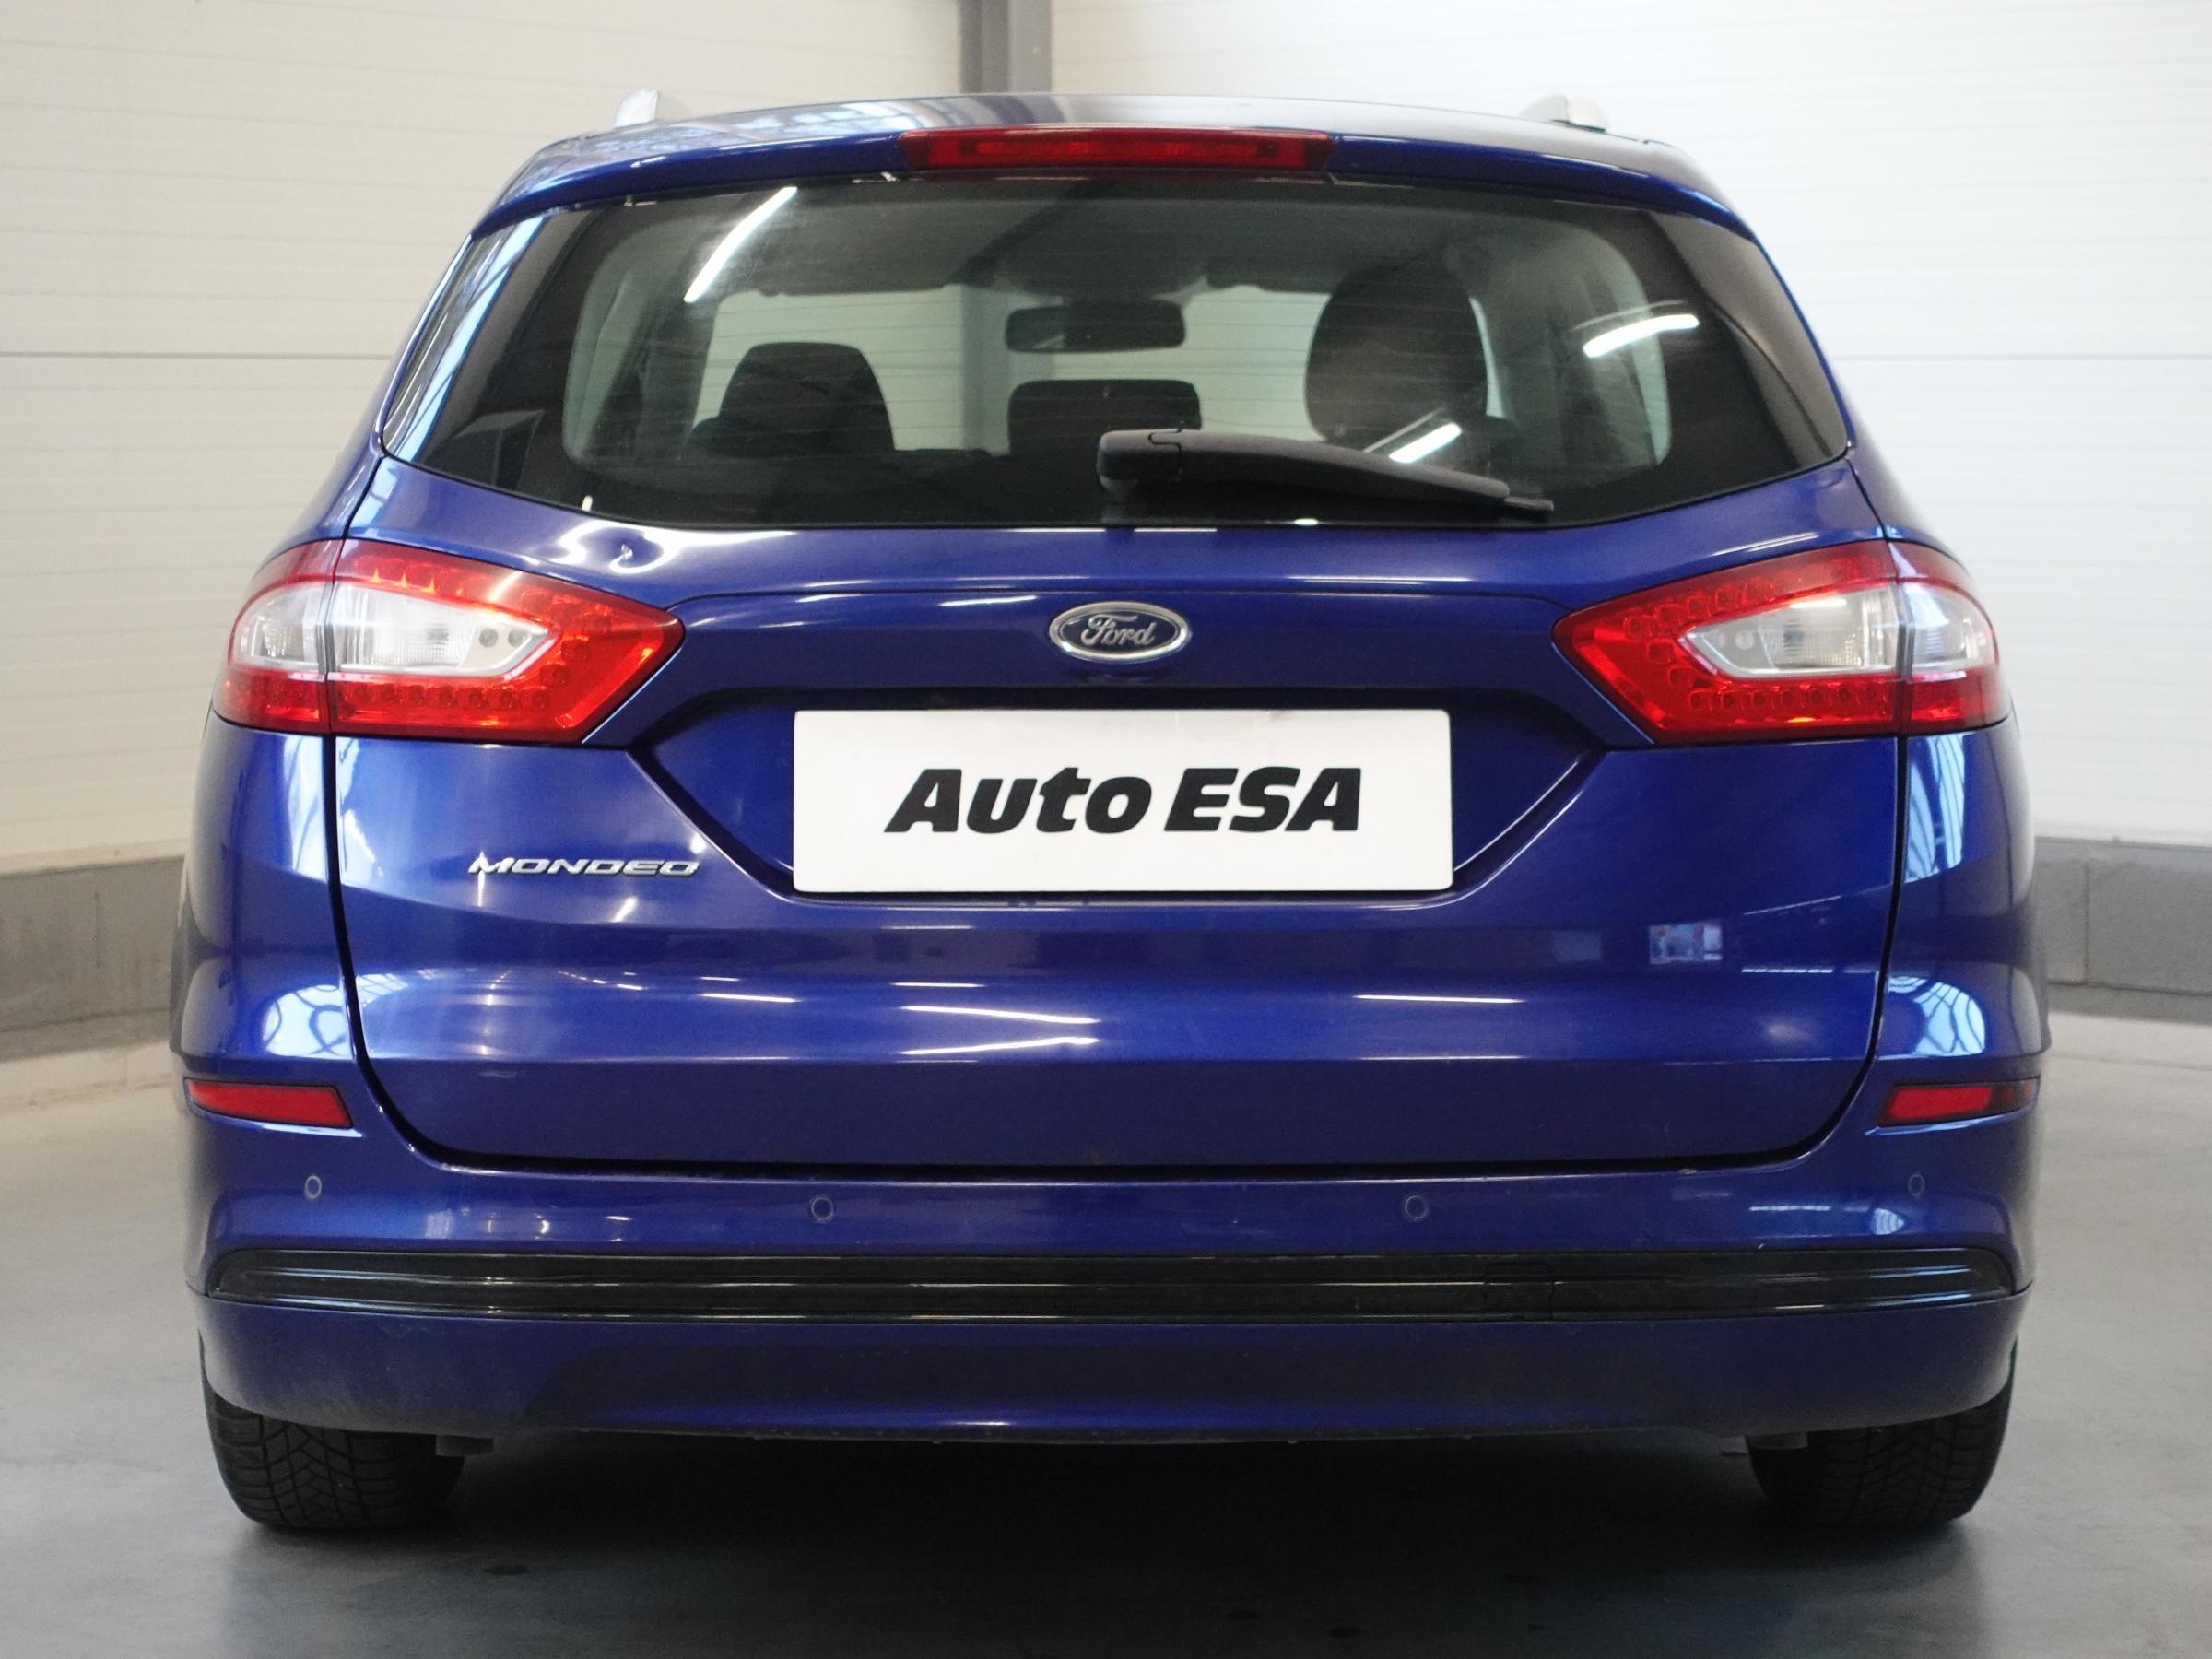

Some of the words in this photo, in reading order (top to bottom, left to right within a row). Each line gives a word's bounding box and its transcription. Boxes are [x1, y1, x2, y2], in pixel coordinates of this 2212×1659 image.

[1080, 613, 1157, 646] Ford
[884, 767, 1151, 833] Auto
[1164, 766, 1360, 832] ESA
[467, 855, 700, 877] MONDEO
